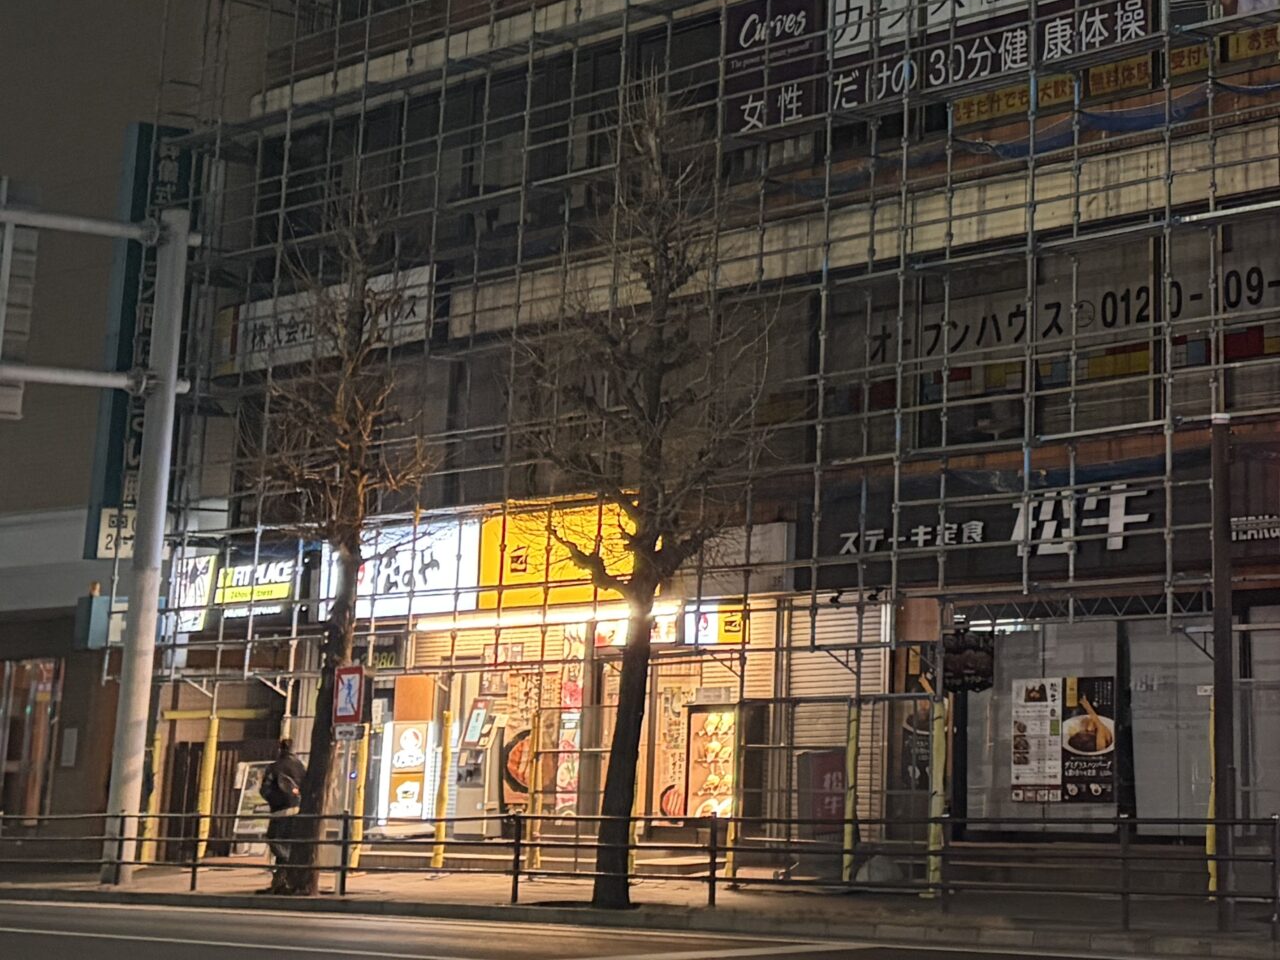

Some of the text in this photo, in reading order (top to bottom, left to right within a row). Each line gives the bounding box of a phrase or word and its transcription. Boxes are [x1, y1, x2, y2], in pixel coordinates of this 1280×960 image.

[739, 10, 807, 48] Curves
[838, 519, 985, 556] ステーキ定食
